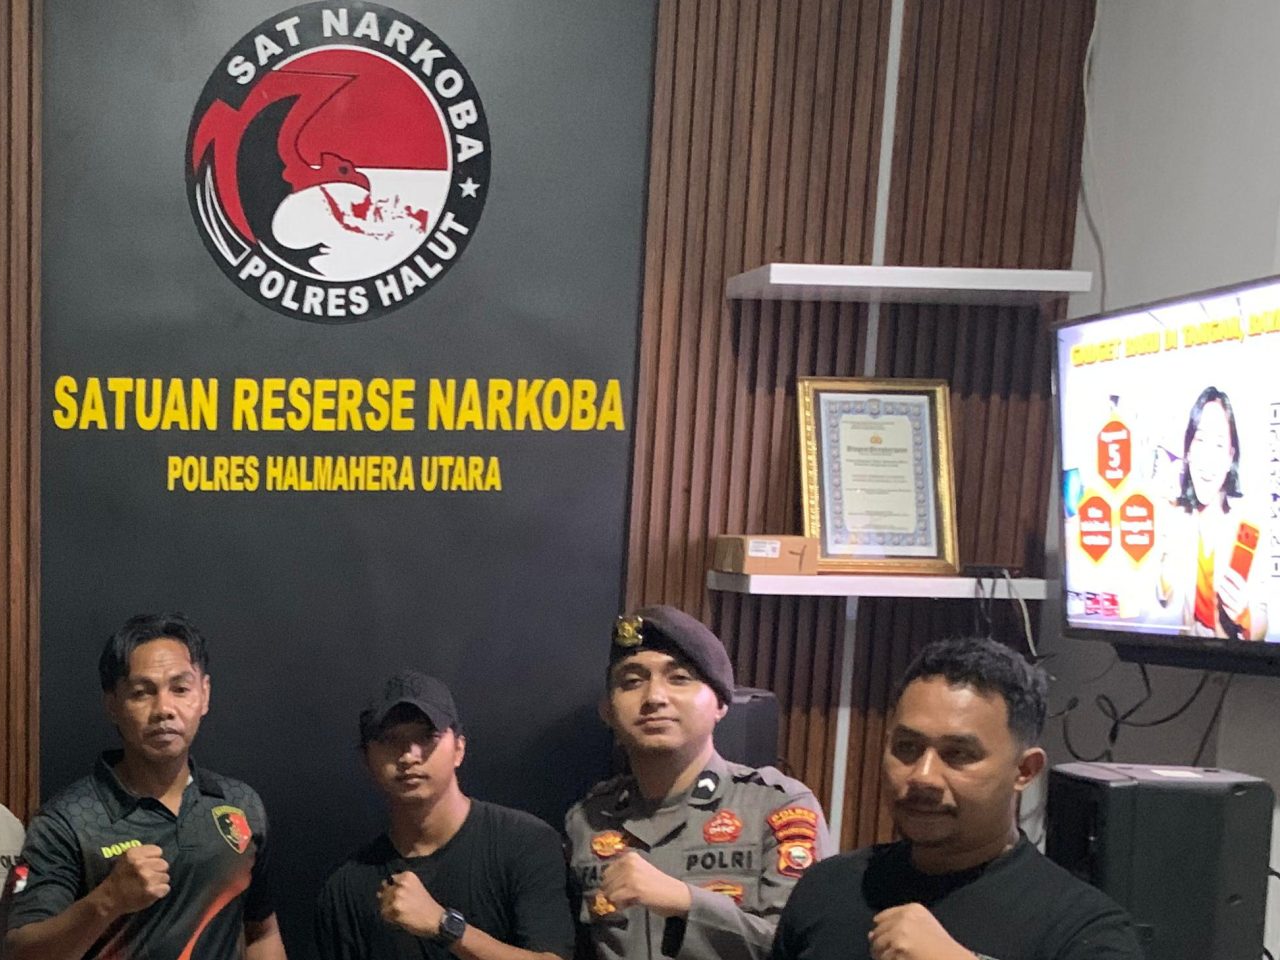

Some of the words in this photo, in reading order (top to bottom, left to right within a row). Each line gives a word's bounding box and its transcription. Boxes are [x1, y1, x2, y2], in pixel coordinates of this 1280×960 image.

[226, 16, 302, 86] SAT
[322, 8, 485, 163] NARKOBA
[240, 254, 371, 317] POLRES
[376, 210, 472, 306] HALUT
[53, 375, 218, 431] SATUAN
[232, 377, 416, 432] RESERSE
[428, 378, 626, 431] NARKOBA
[167, 454, 261, 491] POLRES
[265, 455, 417, 492] HALMAHERA
[421, 456, 503, 491] UTARA
[686, 851, 753, 871] POLRI
